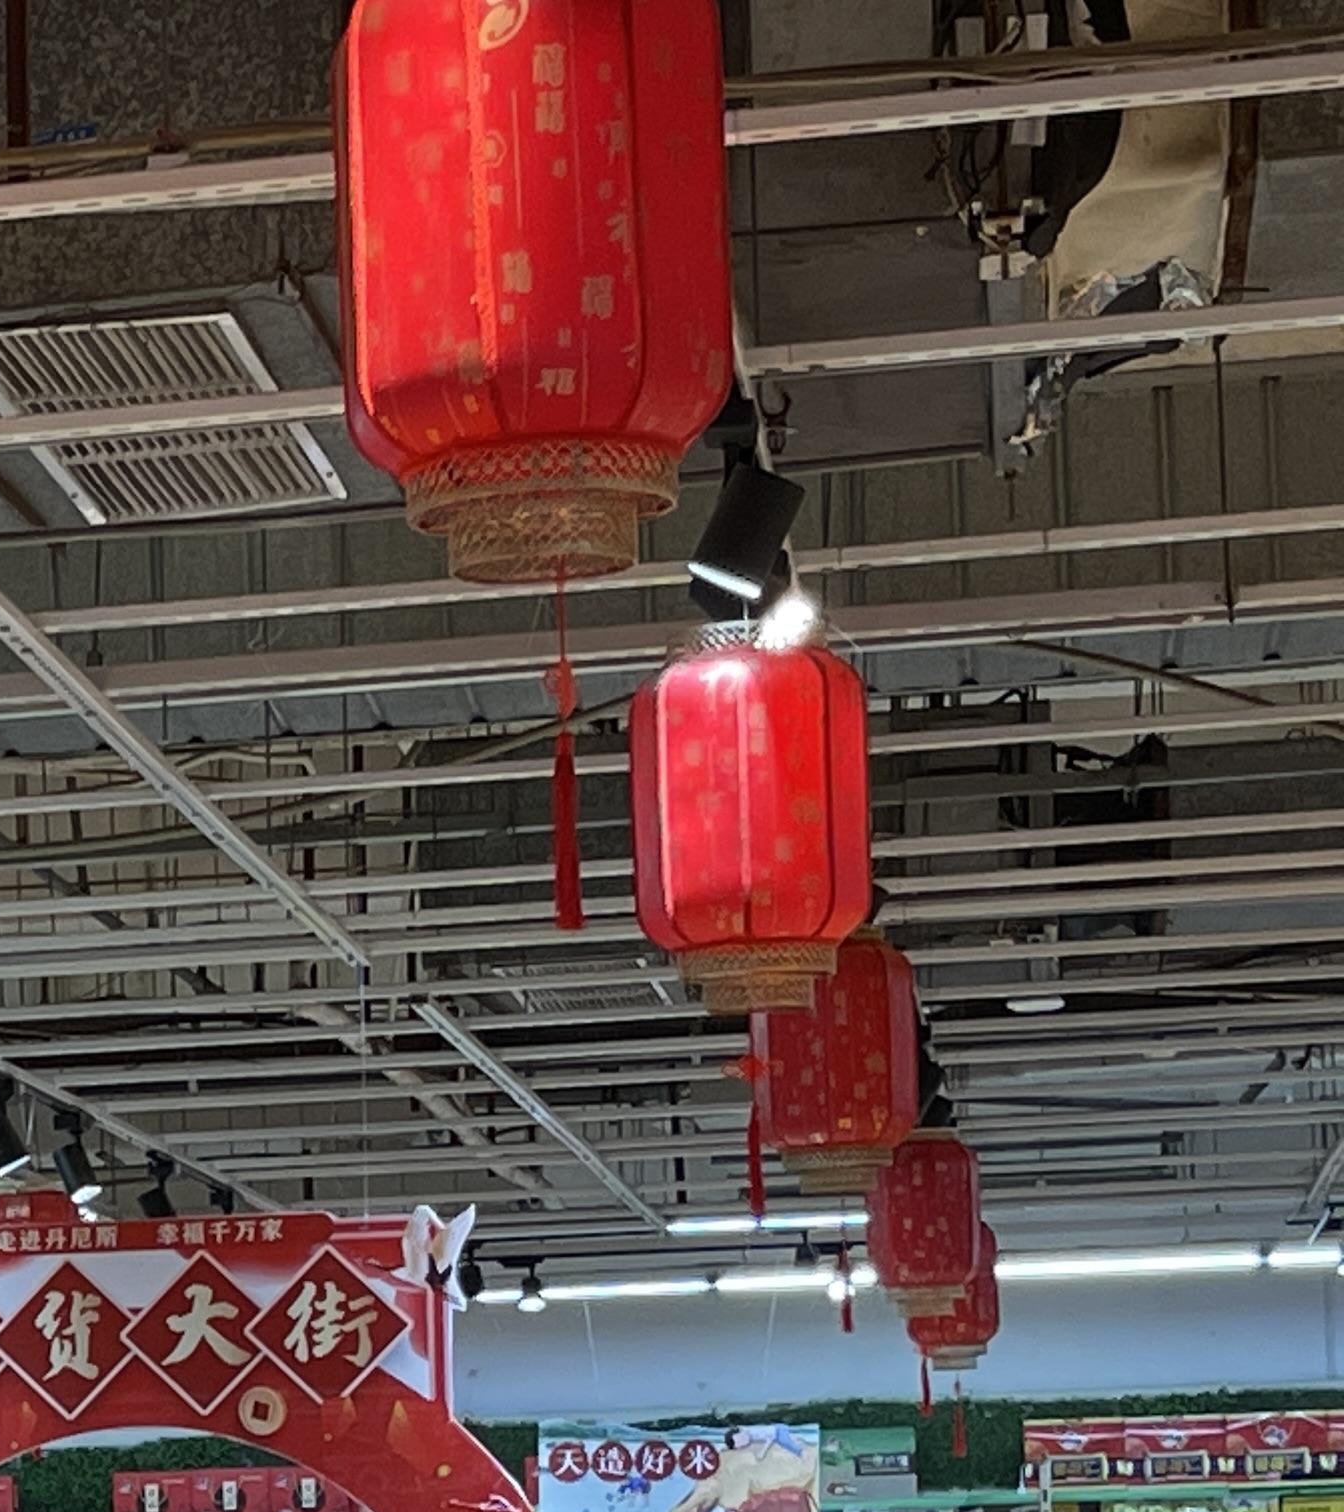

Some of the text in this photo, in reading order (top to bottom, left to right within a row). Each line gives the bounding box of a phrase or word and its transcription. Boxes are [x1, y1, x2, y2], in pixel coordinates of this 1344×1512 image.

[157, 1217, 283, 1245] 幸福千万家
[553, 1444, 714, 1478] 天造好米
